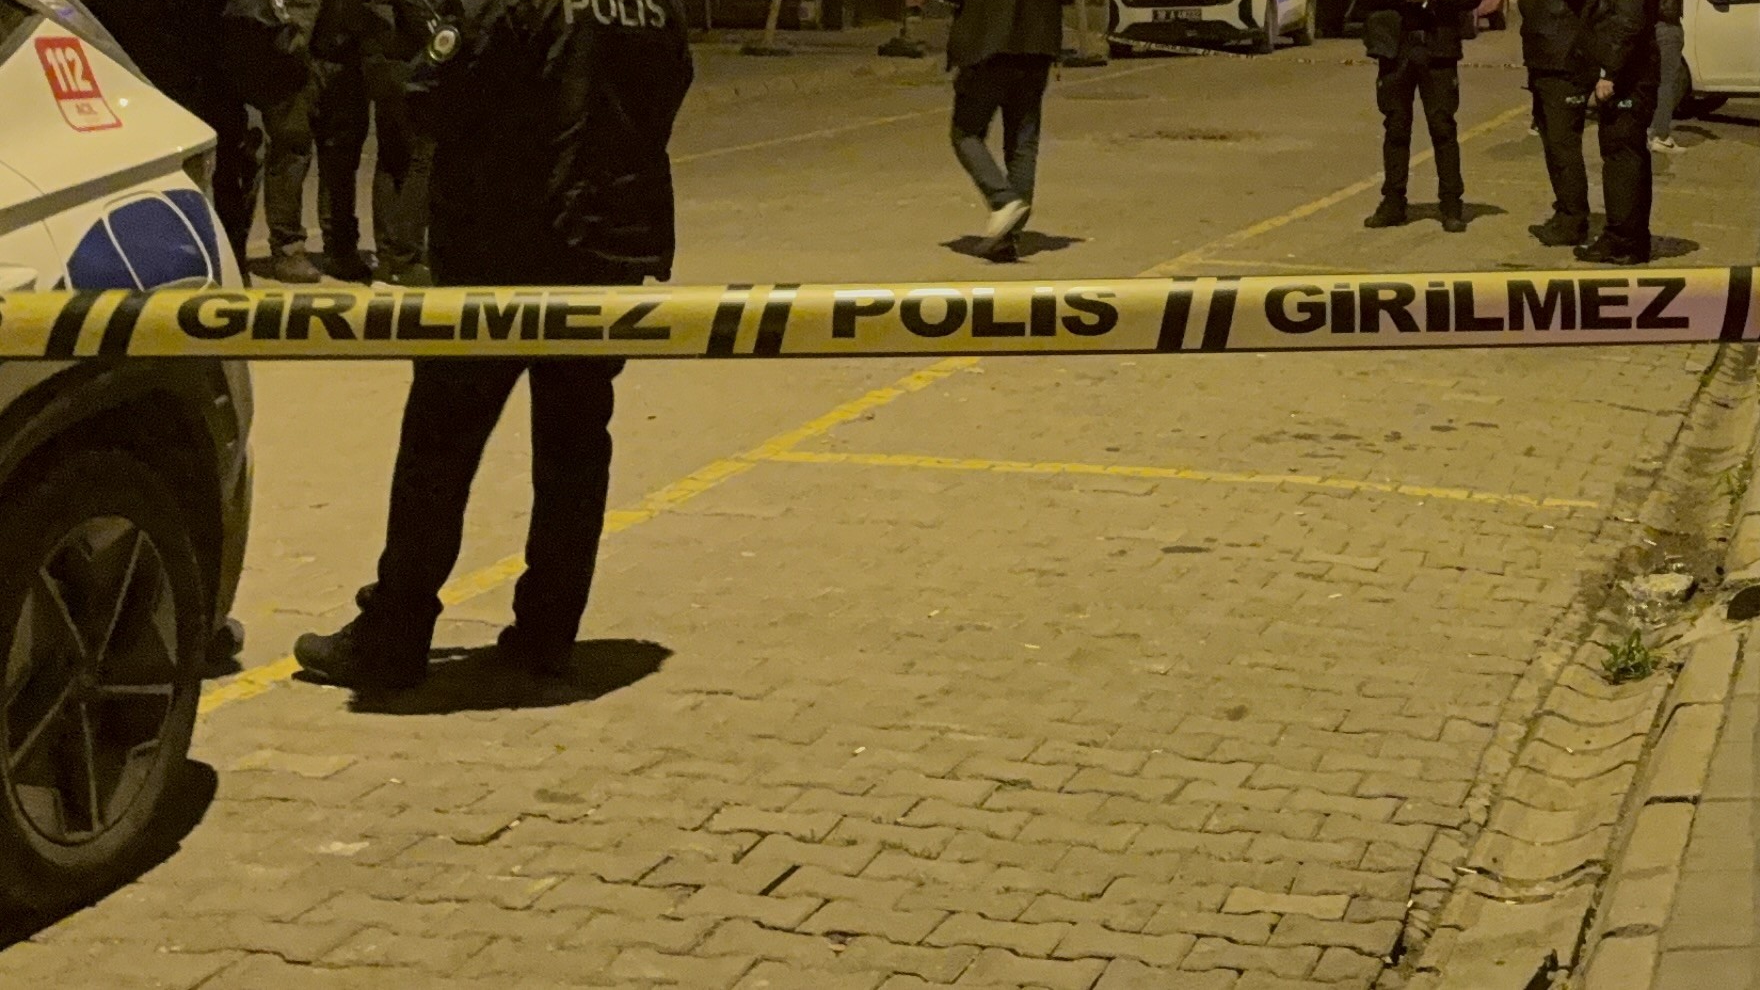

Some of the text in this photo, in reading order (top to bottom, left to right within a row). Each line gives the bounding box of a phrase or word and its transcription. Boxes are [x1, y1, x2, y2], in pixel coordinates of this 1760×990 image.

[44, 45, 94, 93] 112
[177, 289, 672, 341] GİRİLMEZ
[832, 286, 1119, 339] POLİS
[1264, 277, 1690, 335] GİRİLMEZ
